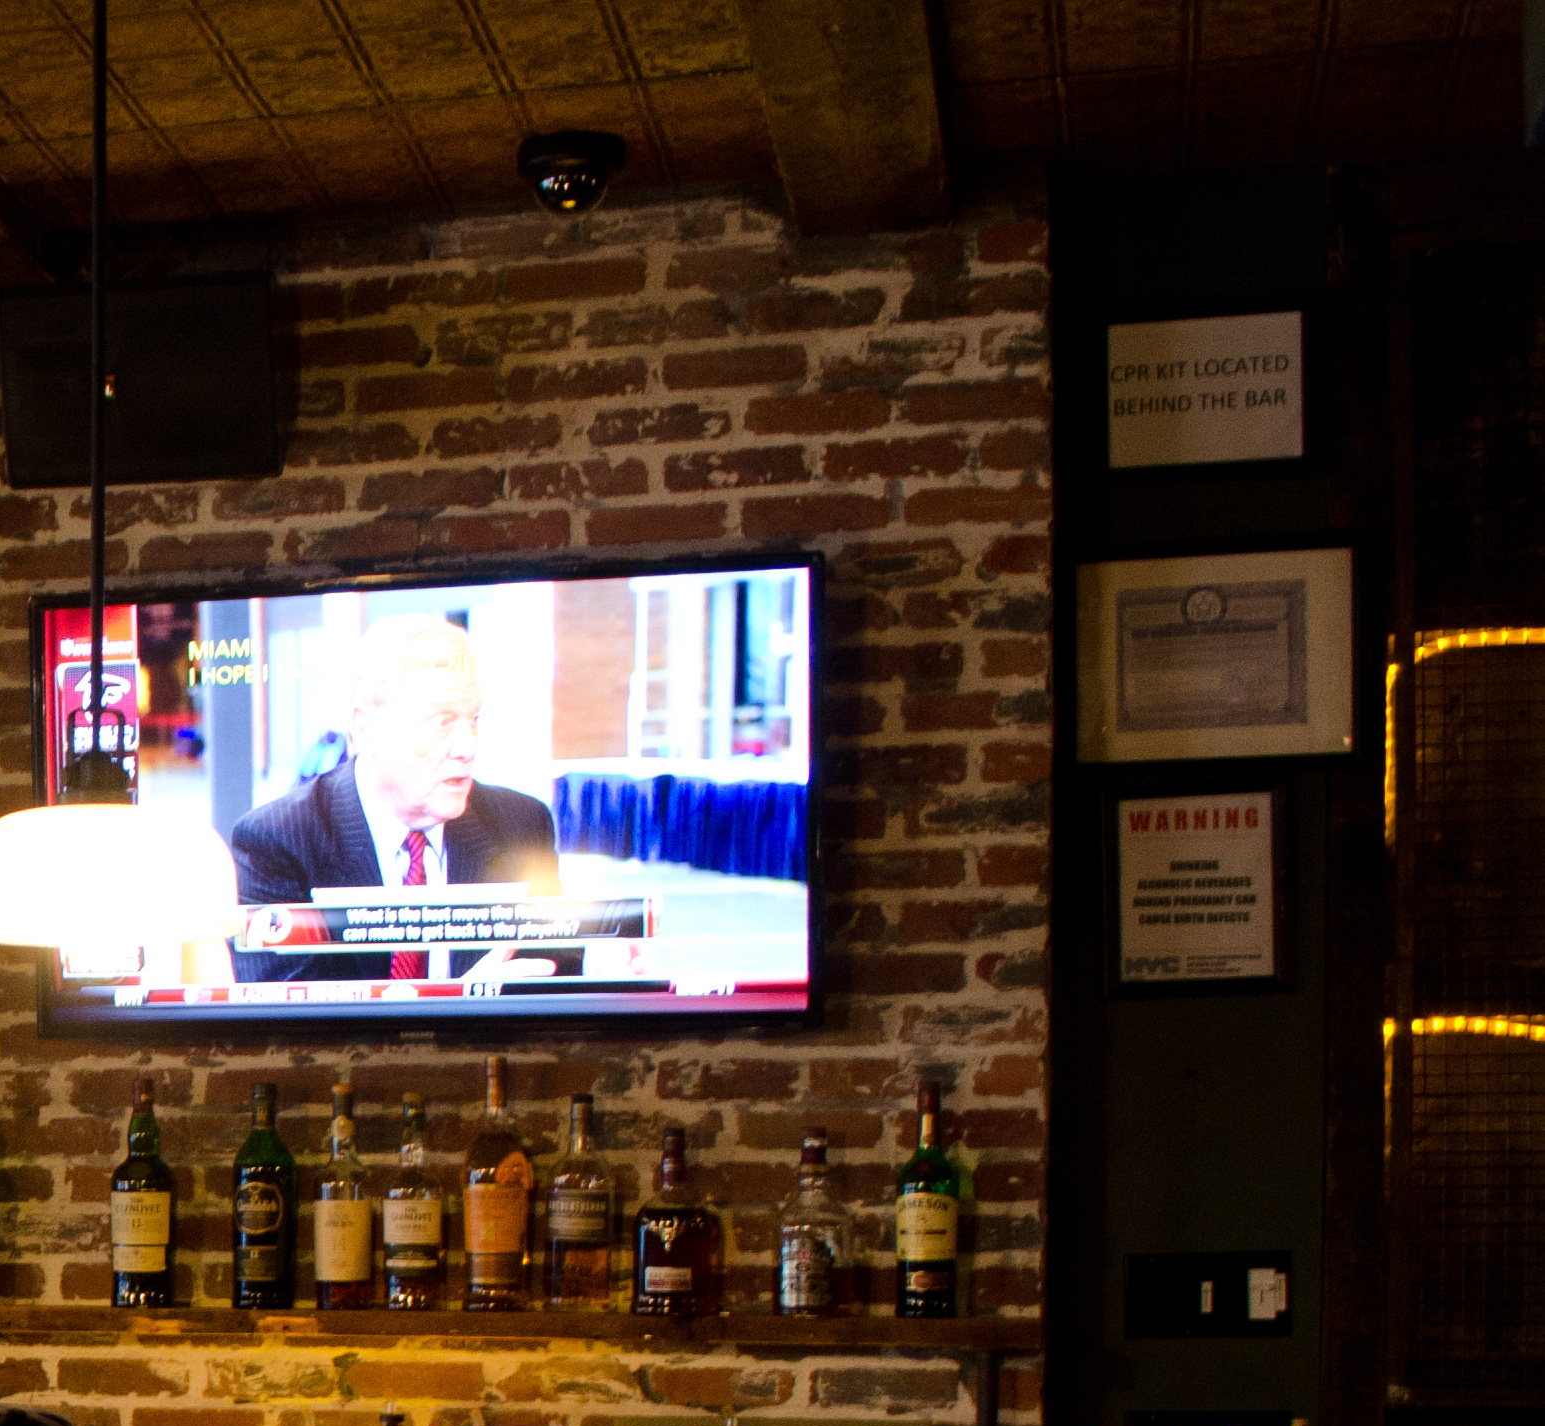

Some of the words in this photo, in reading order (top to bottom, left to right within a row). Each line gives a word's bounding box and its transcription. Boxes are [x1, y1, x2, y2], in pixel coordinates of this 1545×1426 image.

[1111, 364, 1151, 384] CPR
[1156, 361, 1188, 381] KIT
[1194, 354, 1289, 377] LOCATED
[1113, 395, 1192, 417] BEHIND
[1200, 391, 1238, 411] THE
[1245, 388, 1289, 408] BAR
[1129, 806, 1260, 833] WARNING
